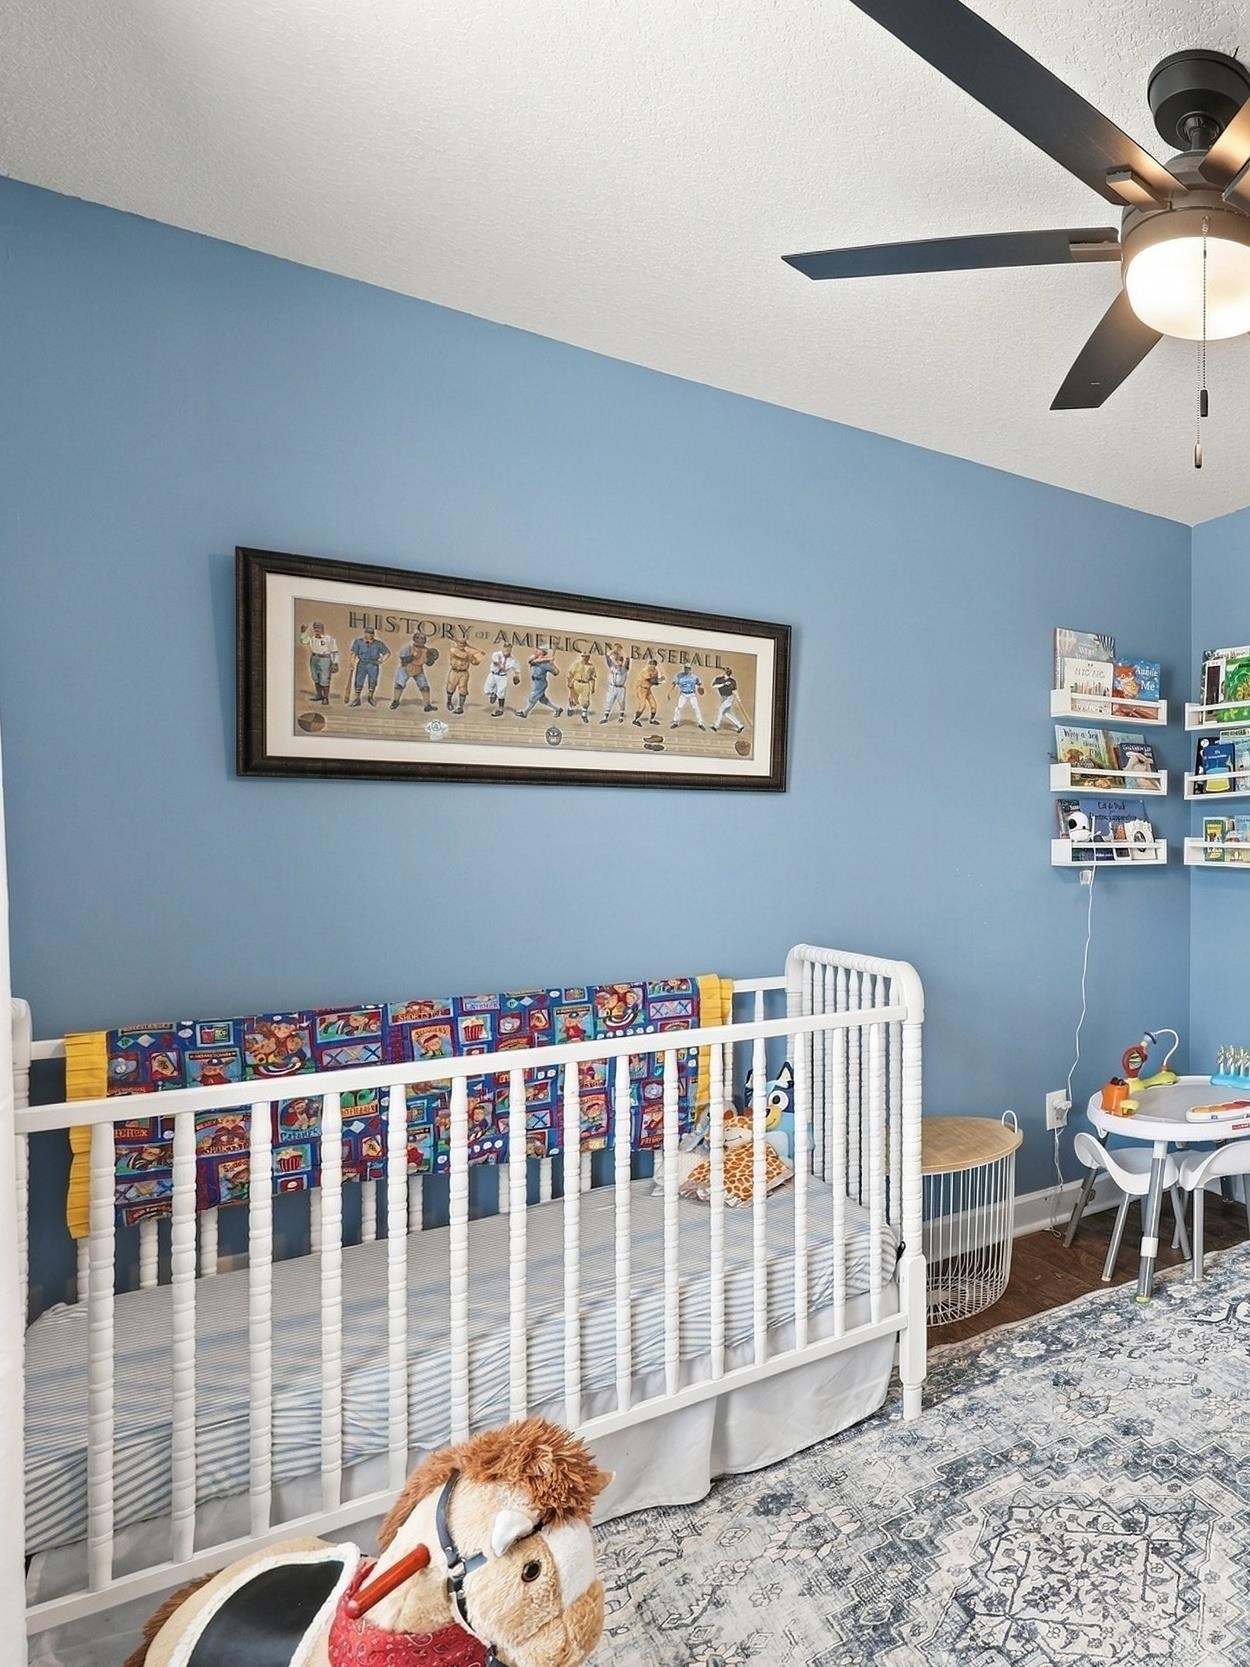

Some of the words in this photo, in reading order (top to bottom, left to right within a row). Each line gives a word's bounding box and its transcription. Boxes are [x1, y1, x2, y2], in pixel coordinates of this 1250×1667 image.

[349, 611, 474, 639] HISTORY
[493, 629, 619, 656] AMERICAN
[630, 644, 726, 670] BASEBALL
